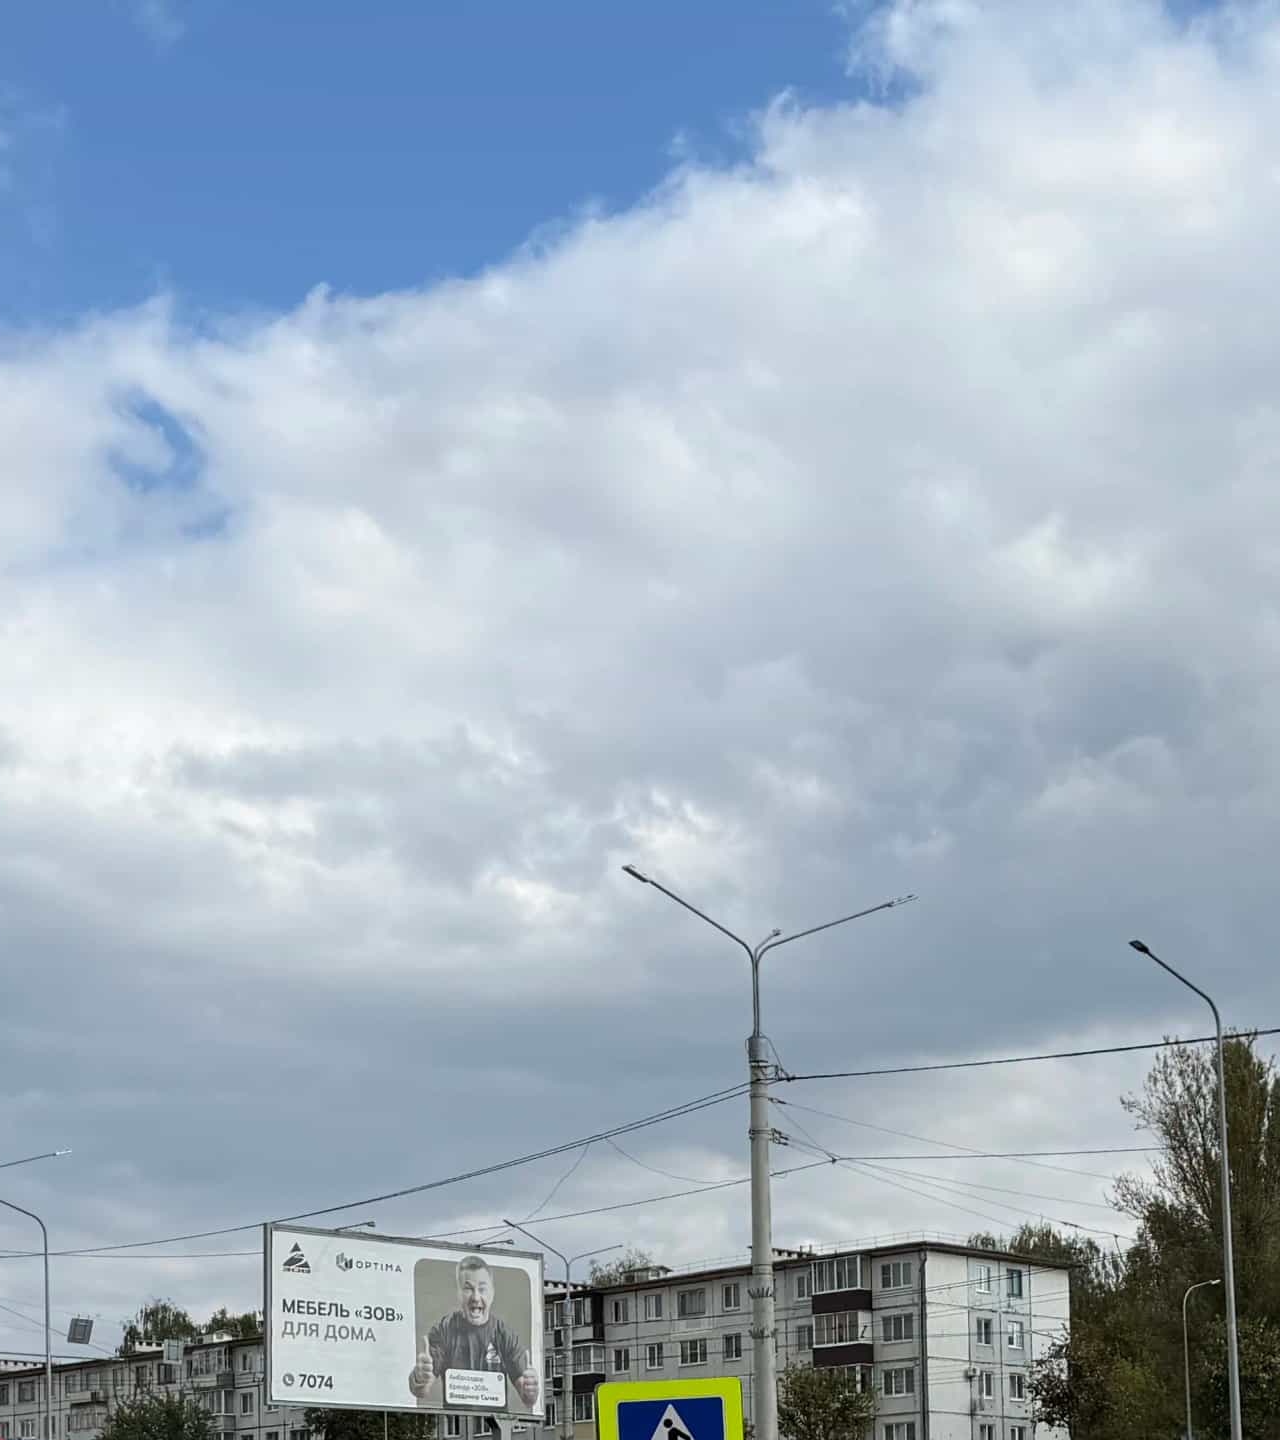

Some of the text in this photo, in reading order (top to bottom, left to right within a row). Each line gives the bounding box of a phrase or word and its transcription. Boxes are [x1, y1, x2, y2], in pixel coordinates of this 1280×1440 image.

[355, 1260, 402, 1273] OPTIMA
[282, 1298, 404, 1321] МЕБЕЛЬ «ЗОВ»
[281, 1320, 376, 1342] ДЛЯ ДОМА
[298, 1374, 333, 1389] 7074
